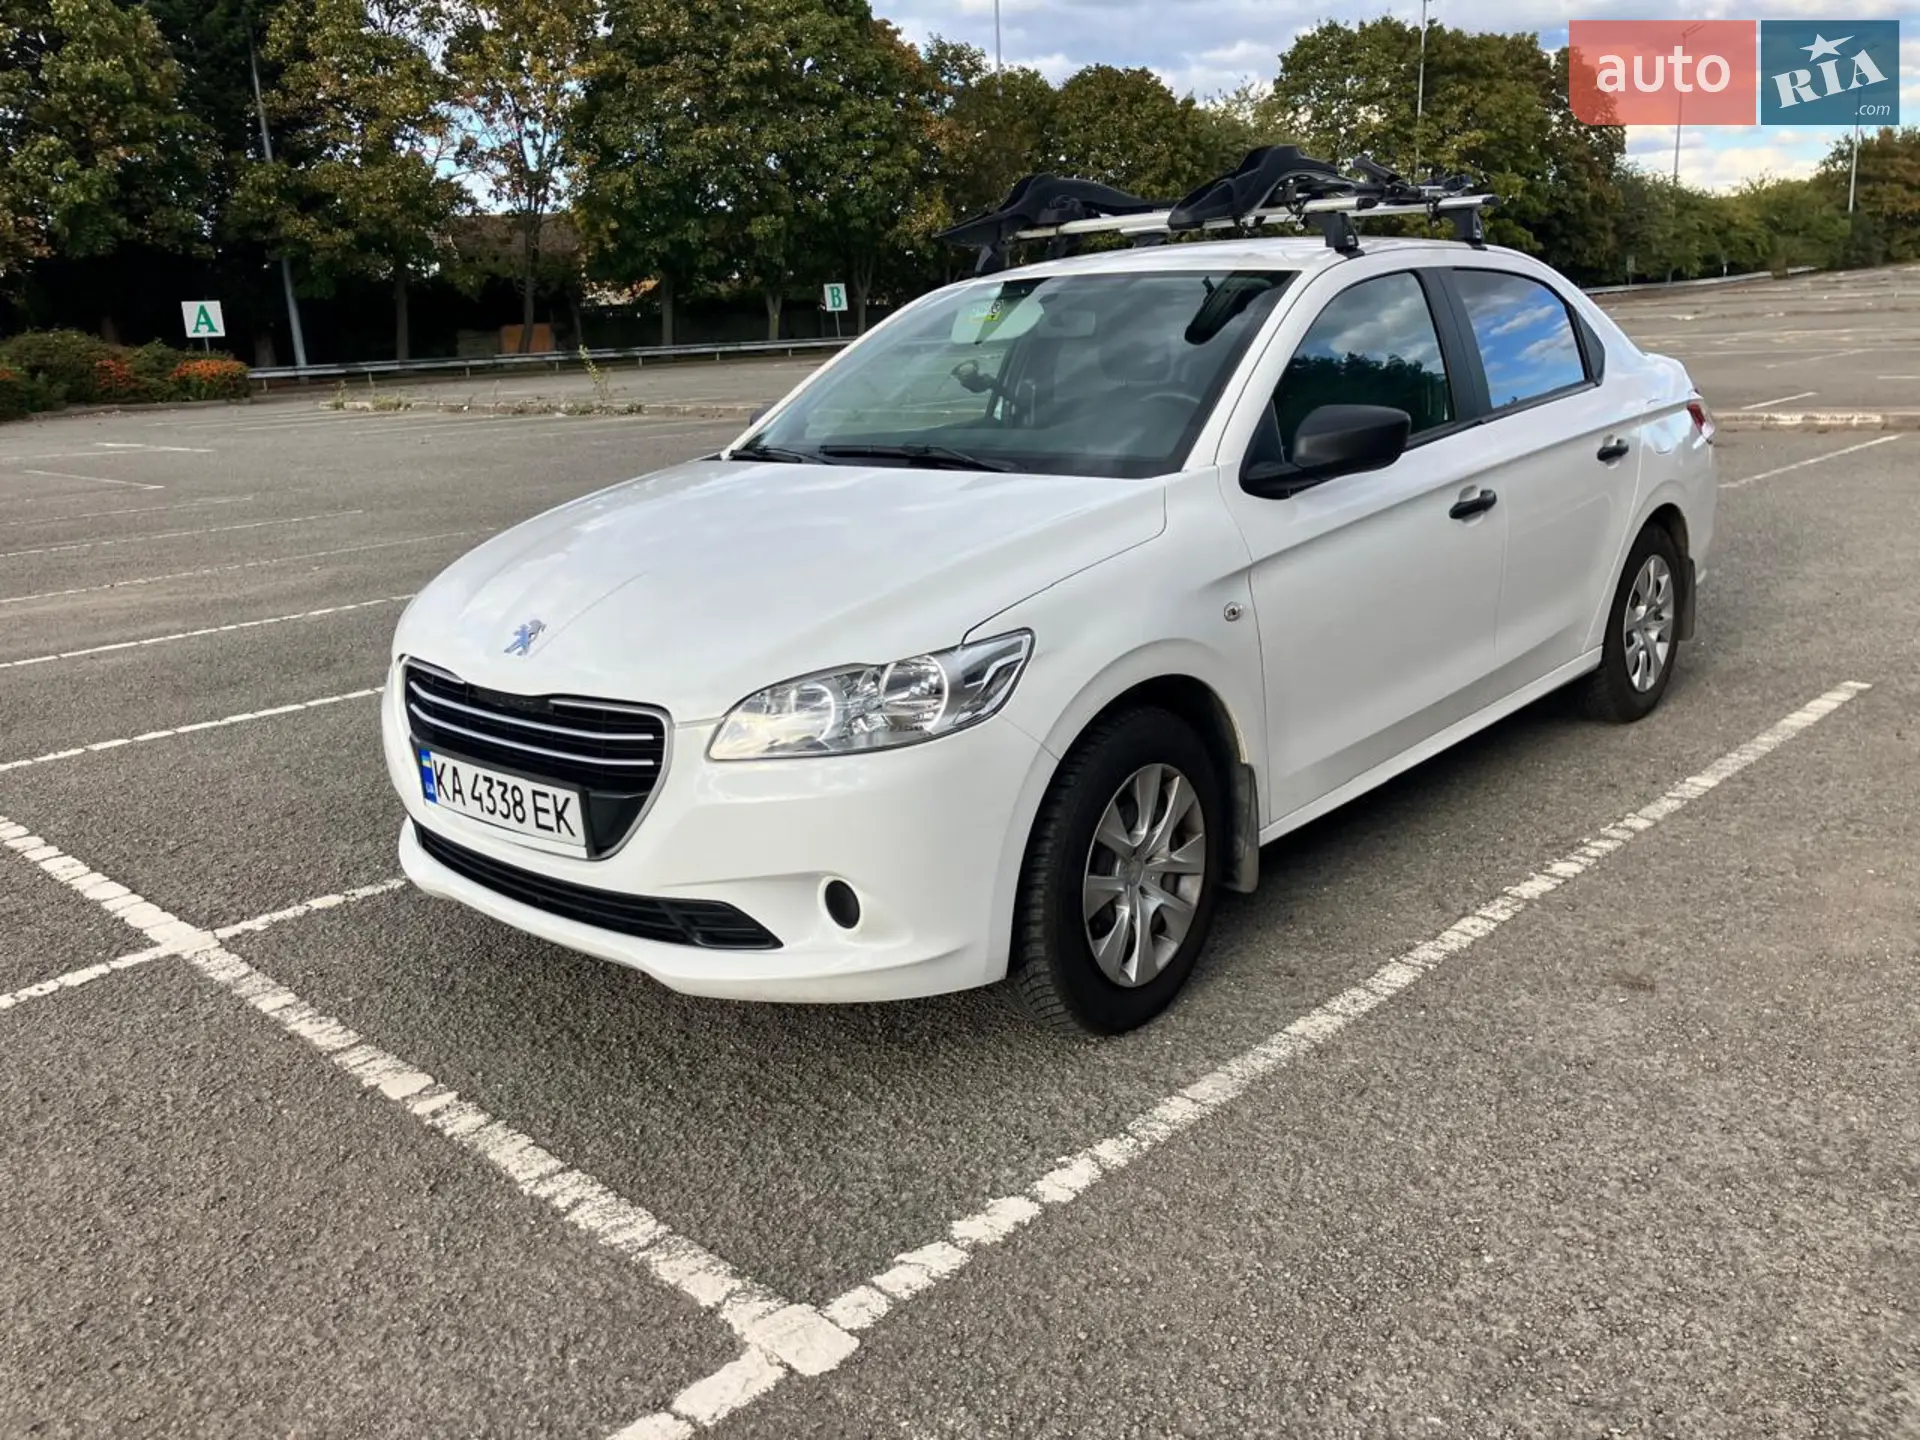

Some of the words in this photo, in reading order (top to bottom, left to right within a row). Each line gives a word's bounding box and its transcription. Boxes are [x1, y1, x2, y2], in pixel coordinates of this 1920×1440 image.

[829, 286, 842, 308] B
[192, 304, 218, 333] A
[433, 760, 467, 806] KA
[470, 773, 526, 825] 4338
[531, 788, 576, 838] EK
